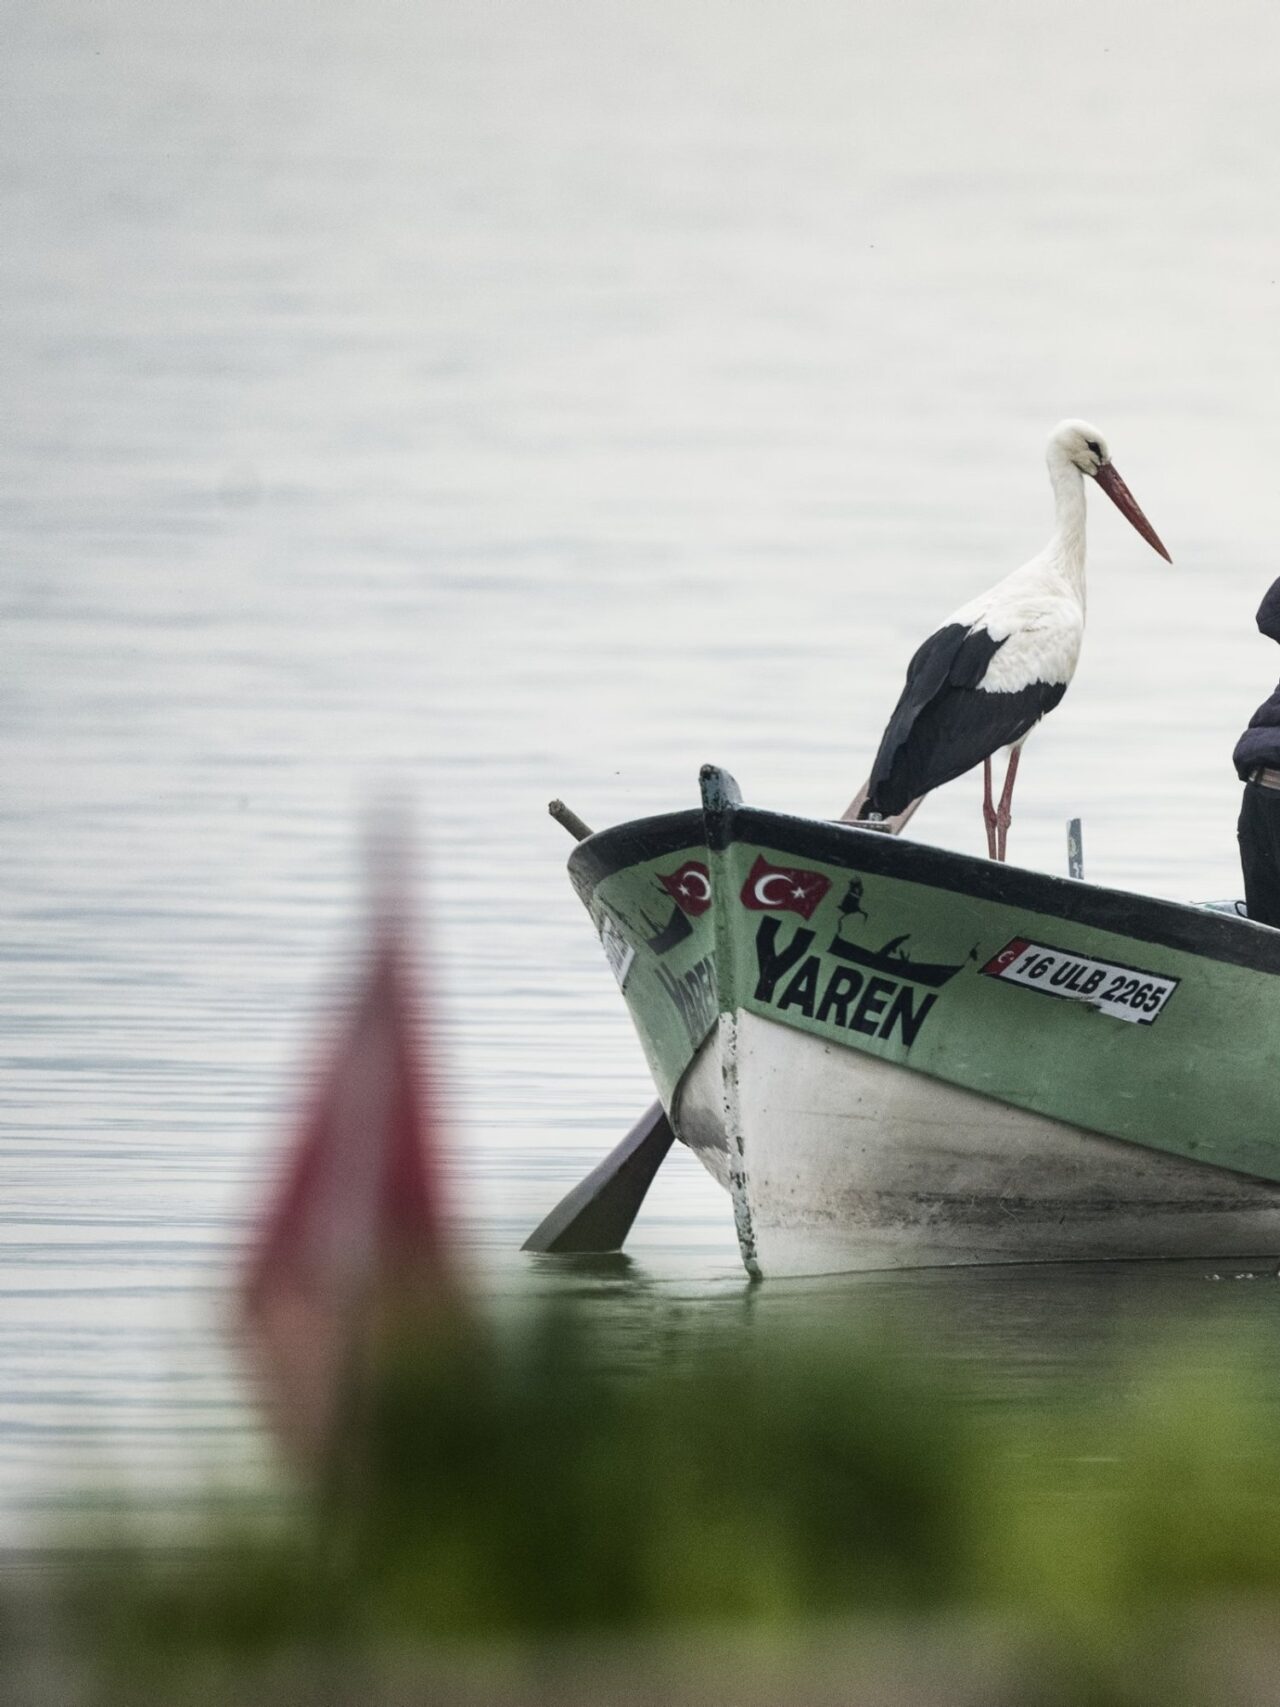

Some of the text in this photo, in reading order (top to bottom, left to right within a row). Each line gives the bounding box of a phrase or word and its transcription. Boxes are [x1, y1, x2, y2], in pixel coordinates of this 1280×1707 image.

[754, 915, 938, 1047] YAREN
[1016, 953, 1168, 1013] 16 ULB 2265
